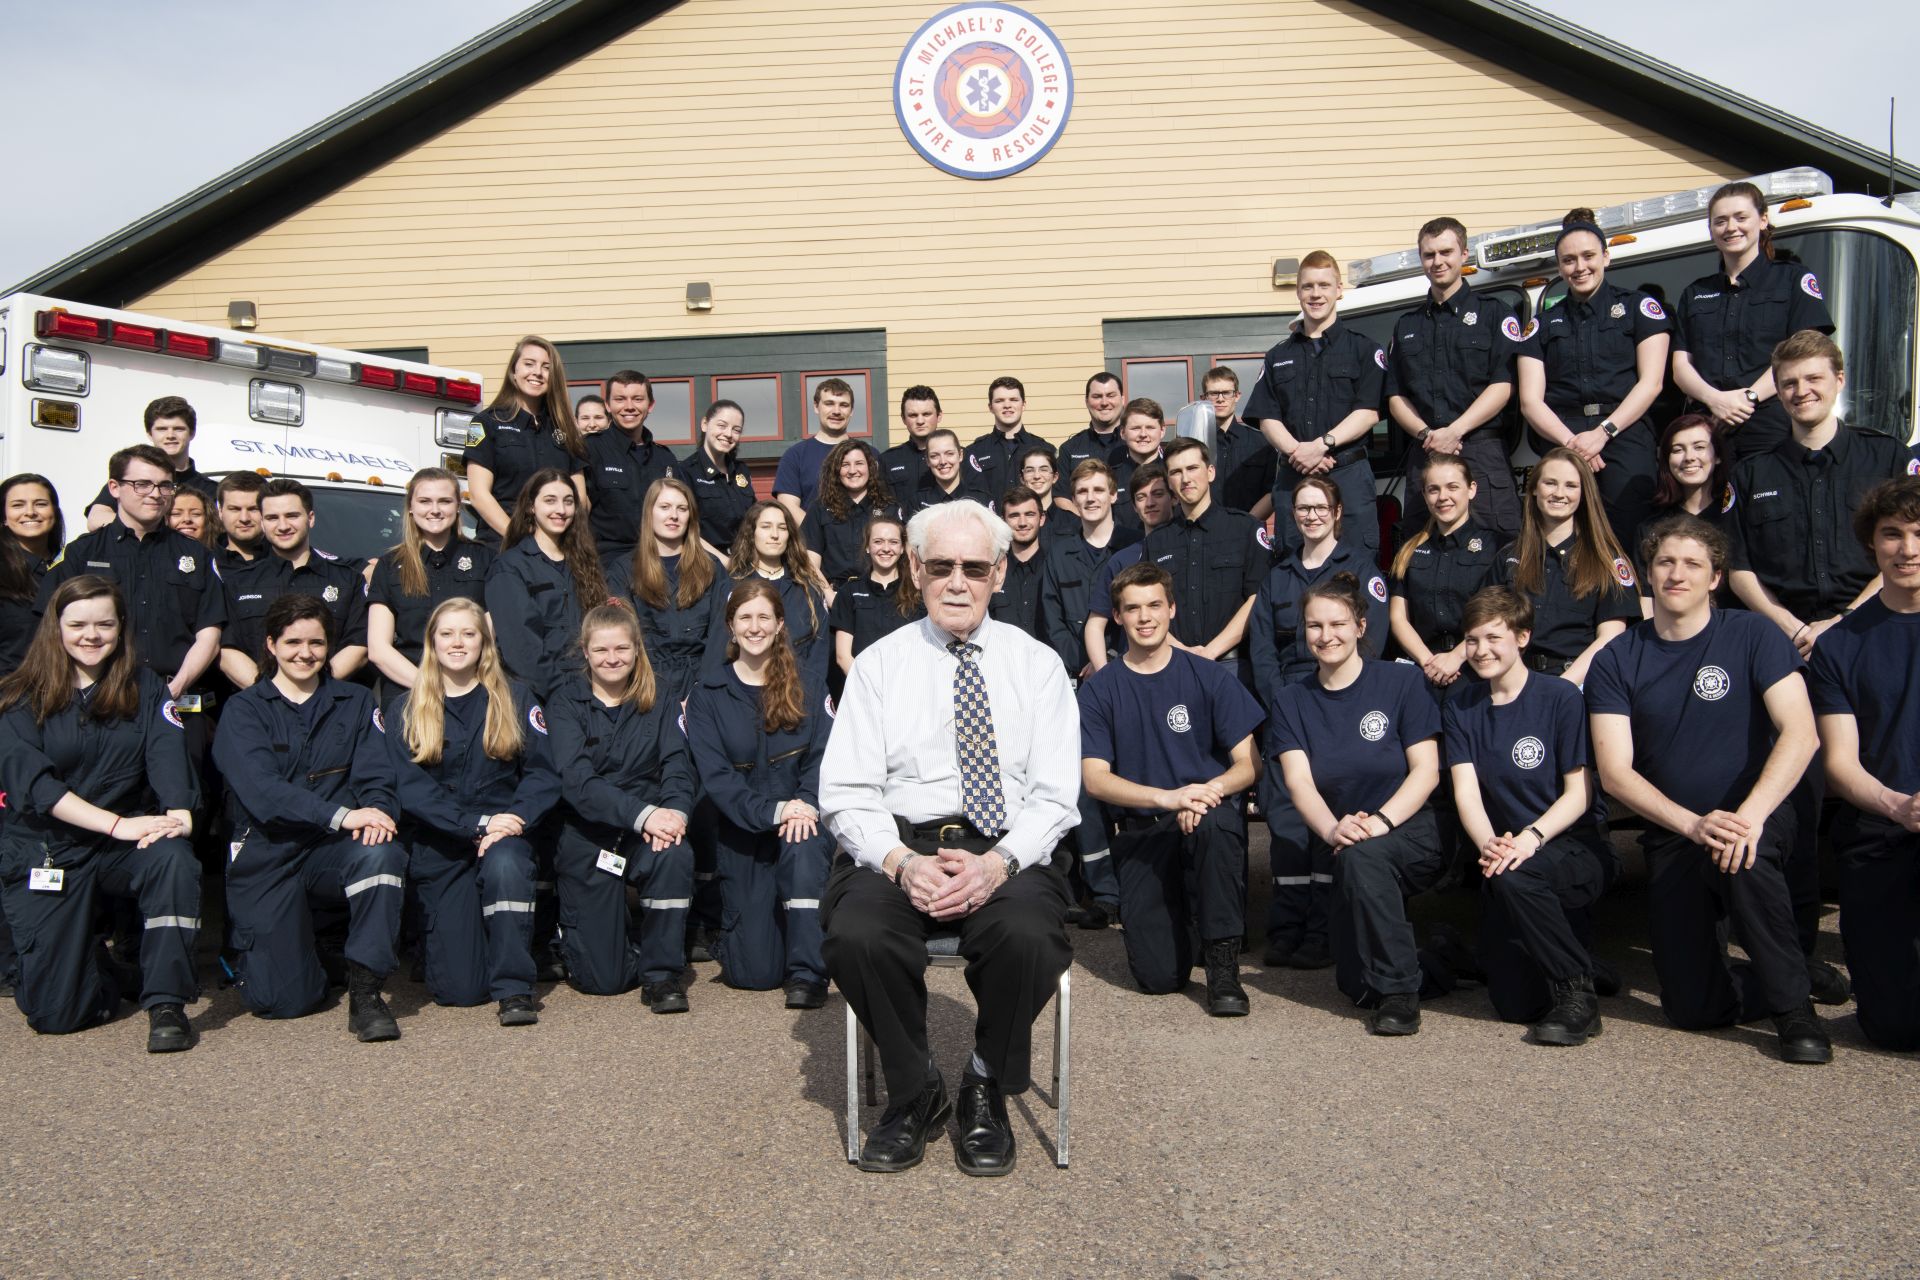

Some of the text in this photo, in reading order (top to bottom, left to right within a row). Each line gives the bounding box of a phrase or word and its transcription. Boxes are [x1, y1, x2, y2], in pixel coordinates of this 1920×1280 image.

[909, 16, 1058, 96] ST. MICHAEL'S COLLEGE
[918, 114, 1050, 162] FIRE & RESCUE
[231, 439, 414, 472] ST. MICHAEL'S
